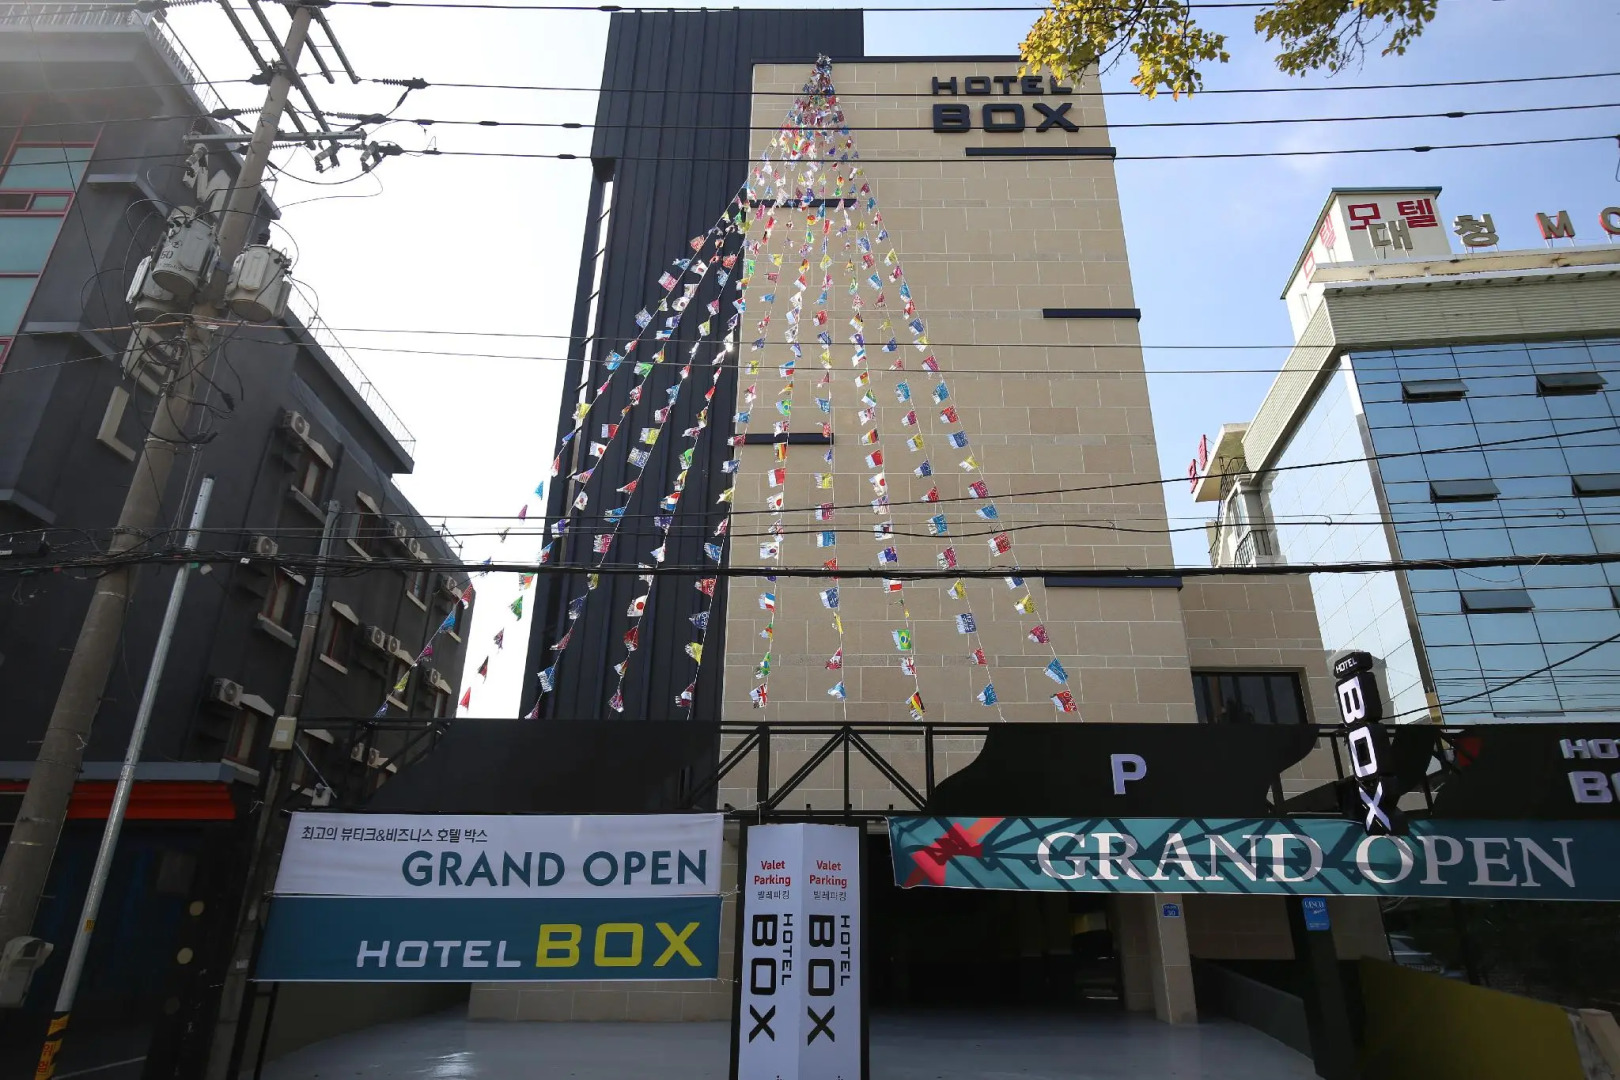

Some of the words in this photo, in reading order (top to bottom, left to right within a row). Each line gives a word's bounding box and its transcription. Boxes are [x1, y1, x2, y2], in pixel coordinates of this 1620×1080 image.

[932, 76, 1073, 95] HOTEL
[933, 103, 1079, 133] BOX
[1348, 198, 1438, 230] 모텔
[1366, 213, 1499, 250] 대청
[1335, 657, 1358, 674] HOTEL
[1337, 676, 1392, 831] BOX
[1111, 753, 1147, 795] P
[1567, 771, 1620, 803] B
[301, 825, 338, 841] 최고의
[341, 827, 433, 843] 뷰티크&비즈니스
[436, 828, 461, 843] 호텔
[464, 828, 488, 843] 박스
[402, 849, 565, 888] GRAND
[582, 849, 707, 886] OPEN
[760, 860, 786, 870] Valet
[816, 860, 842, 871] Valet
[1037, 832, 1323, 882] GRAND
[1356, 835, 1576, 887] OPEN
[754, 874, 791, 887] Parking
[757, 889, 790, 901] 발레파킹
[809, 875, 847, 889] Parking
[813, 890, 847, 901] 발레파킹
[356, 940, 521, 968] HOTEL
[535, 922, 703, 968] BOX
[781, 913, 793, 986] HOTEL
[840, 915, 851, 987] HOTEL
[749, 914, 778, 1043] BOX
[807, 914, 835, 1046] BOX
